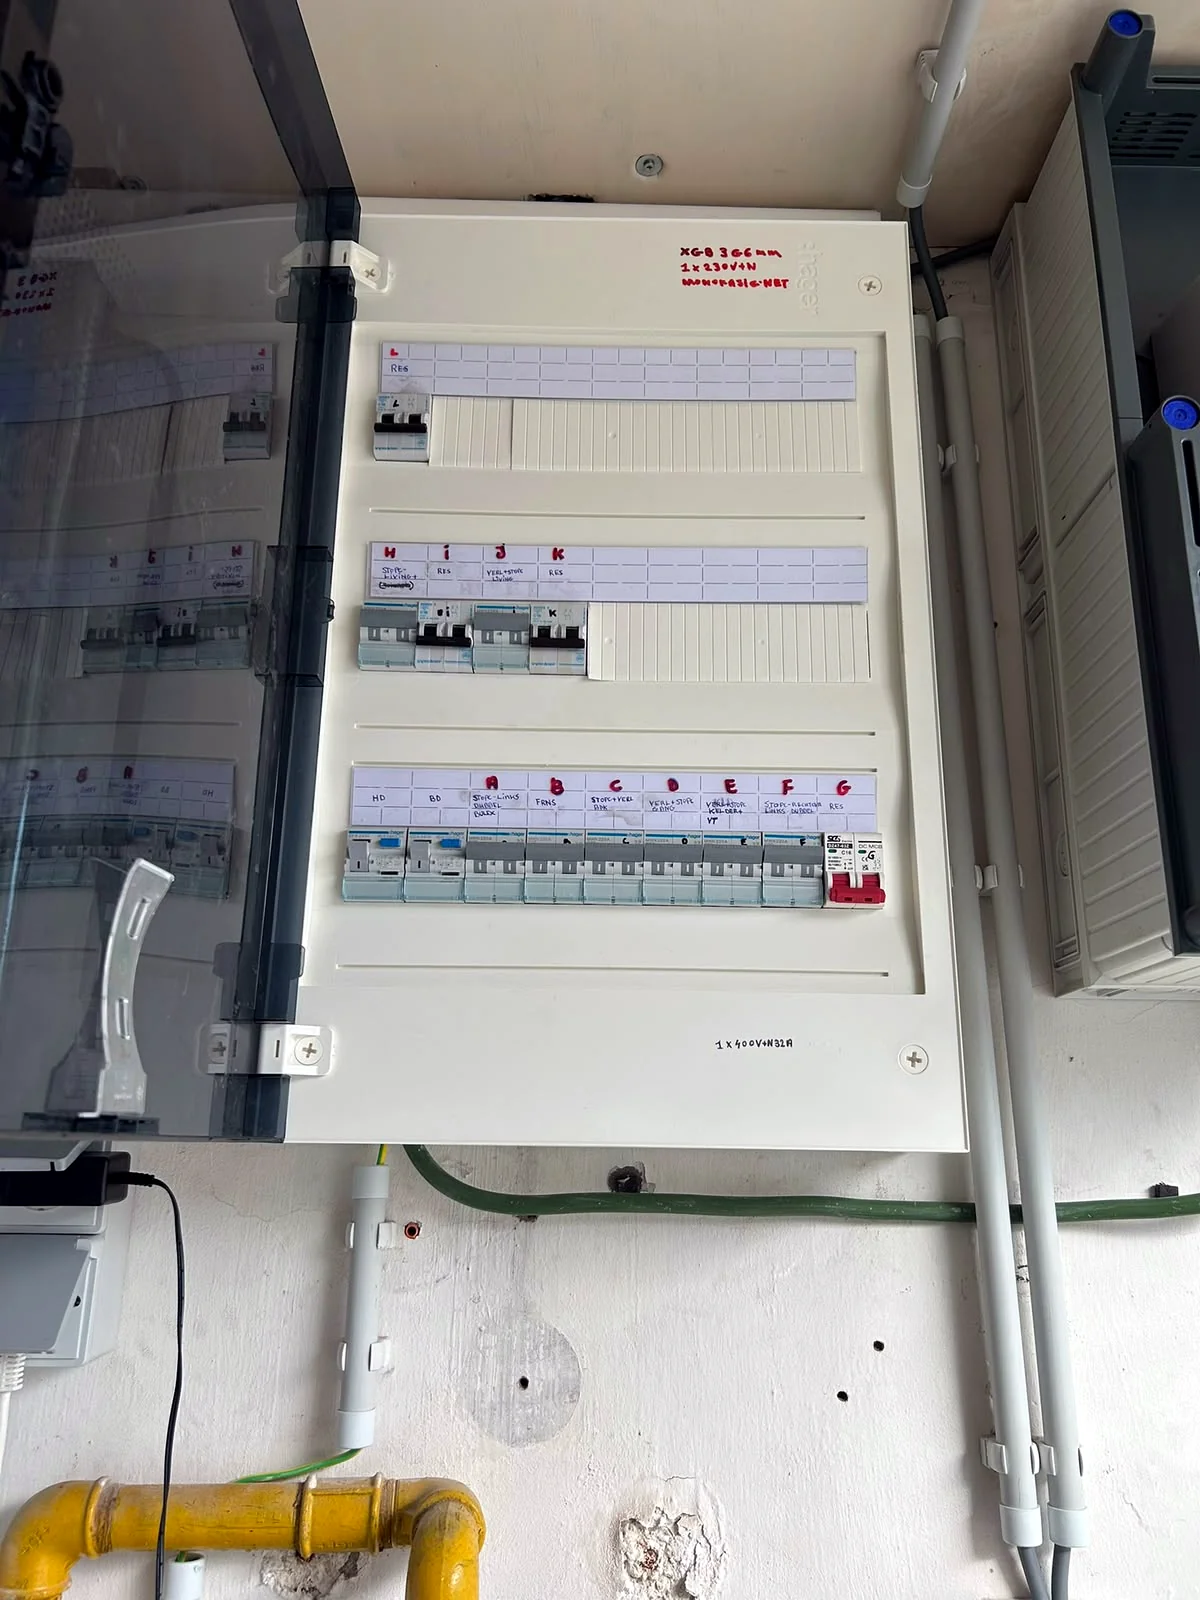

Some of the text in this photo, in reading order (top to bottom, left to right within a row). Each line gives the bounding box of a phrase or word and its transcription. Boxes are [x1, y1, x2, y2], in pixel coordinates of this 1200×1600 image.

[384, 546, 396, 559] H
[552, 547, 565, 561] K
[485, 775, 499, 791] A
[550, 776, 565, 796] B
[609, 779, 623, 793] C
[667, 777, 679, 793] D
[724, 778, 738, 794] E
[782, 778, 794, 795] F
[836, 779, 851, 796] G
